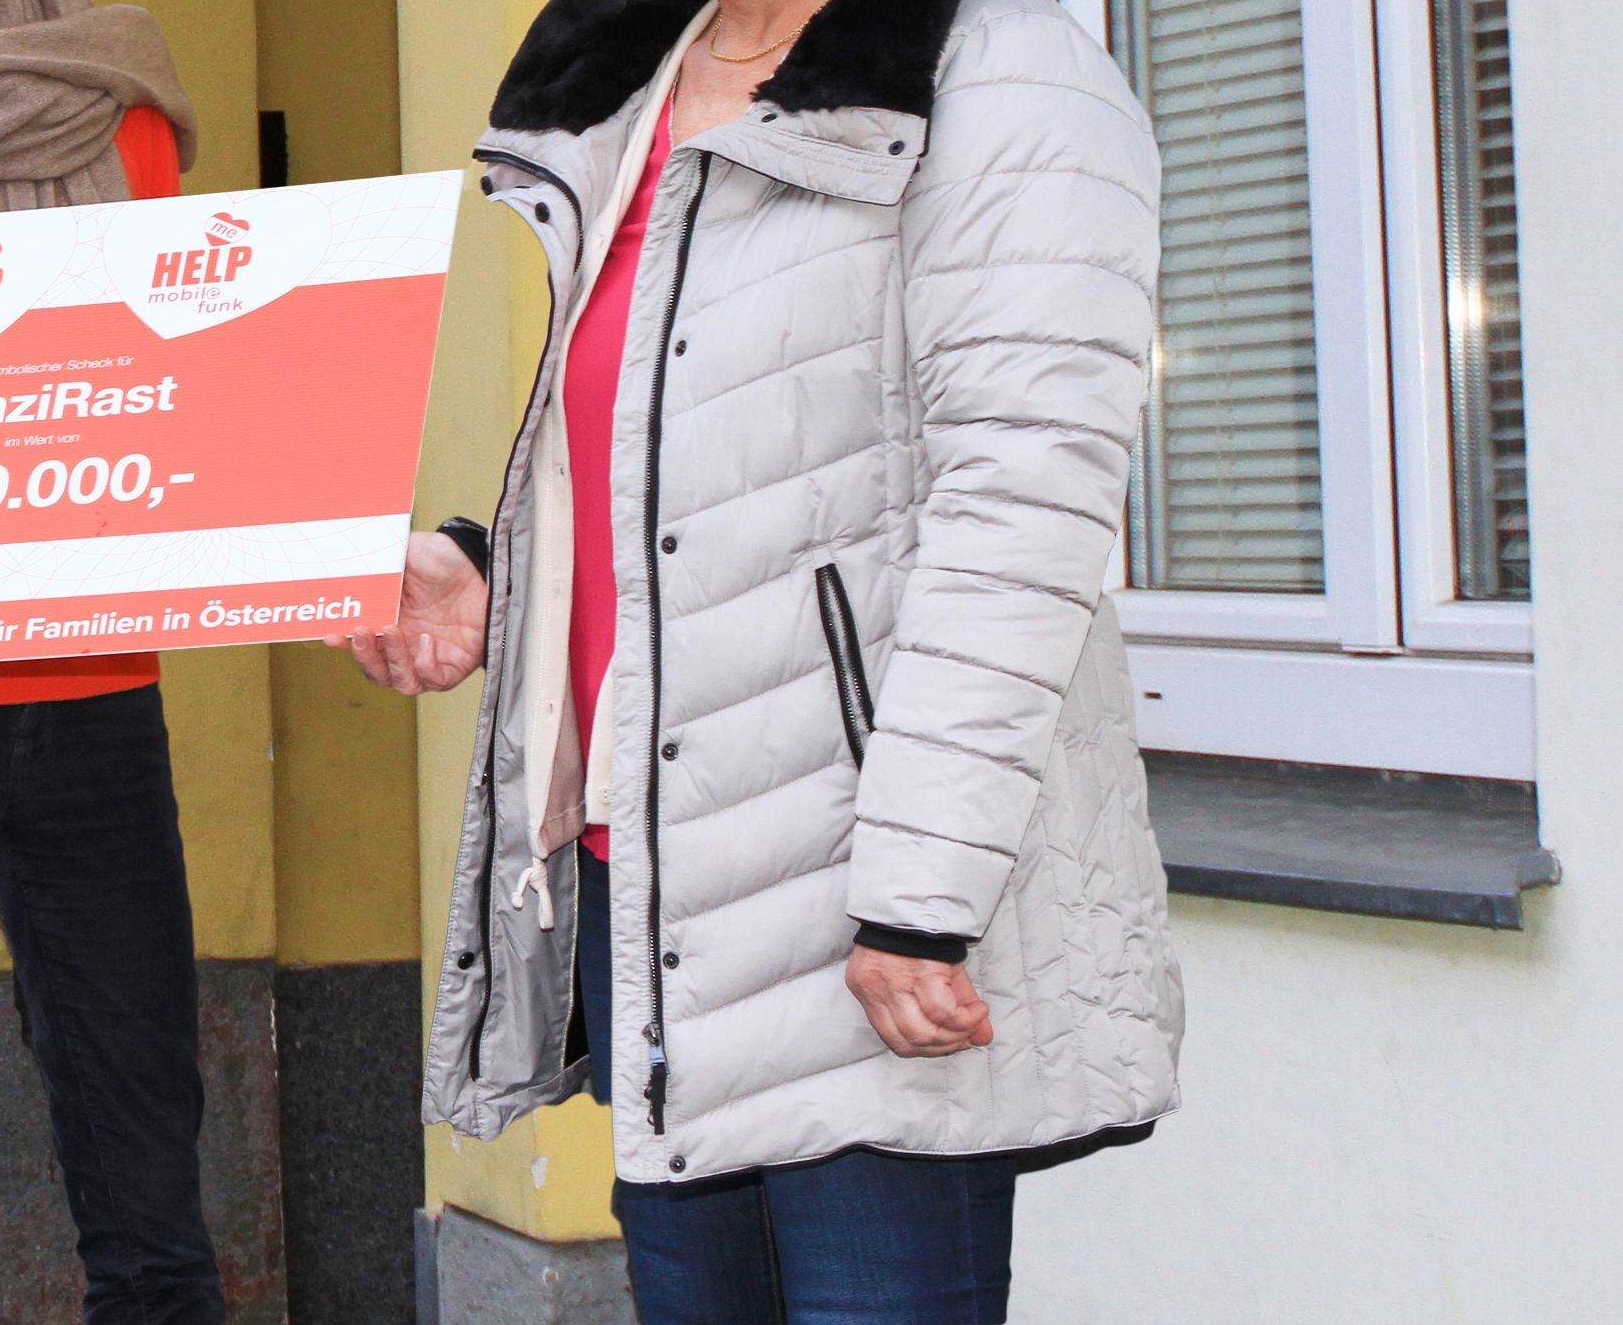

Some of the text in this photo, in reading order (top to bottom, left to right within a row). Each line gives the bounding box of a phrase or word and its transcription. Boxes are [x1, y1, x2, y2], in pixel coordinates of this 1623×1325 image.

[211, 221, 238, 239] me
[151, 246, 252, 288] HELP
[198, 297, 244, 314] funk
[67, 356, 113, 372] Scheck
[116, 354, 135, 367] für
[4, 432, 80, 448] im Wert von
[24, 610, 155, 640] Familien
[161, 606, 190, 631] in
[199, 595, 362, 628] Österreich
